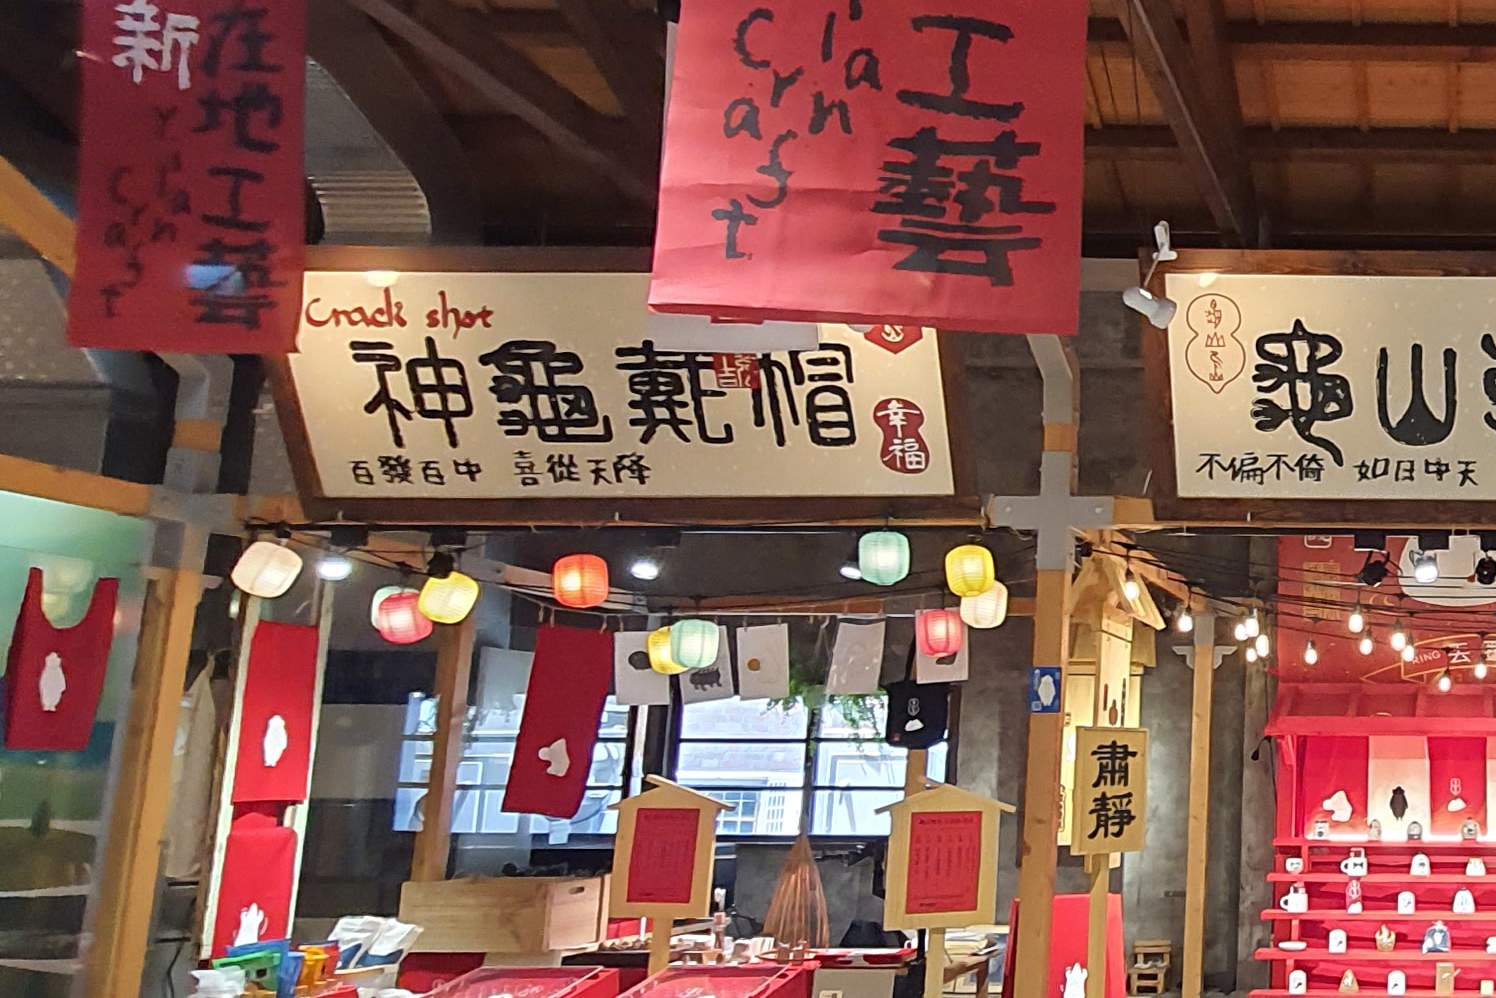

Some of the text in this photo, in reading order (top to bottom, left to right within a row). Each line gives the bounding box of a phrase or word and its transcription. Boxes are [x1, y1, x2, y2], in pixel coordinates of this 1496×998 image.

[112, 0, 200, 89] 新
[869, 14, 1057, 287] 工藝
[426, 290, 494, 340] shot
[1195, 452, 1480, 488] 不偏不倚 如日中天
[1087, 740, 1138, 840] 肅靜
